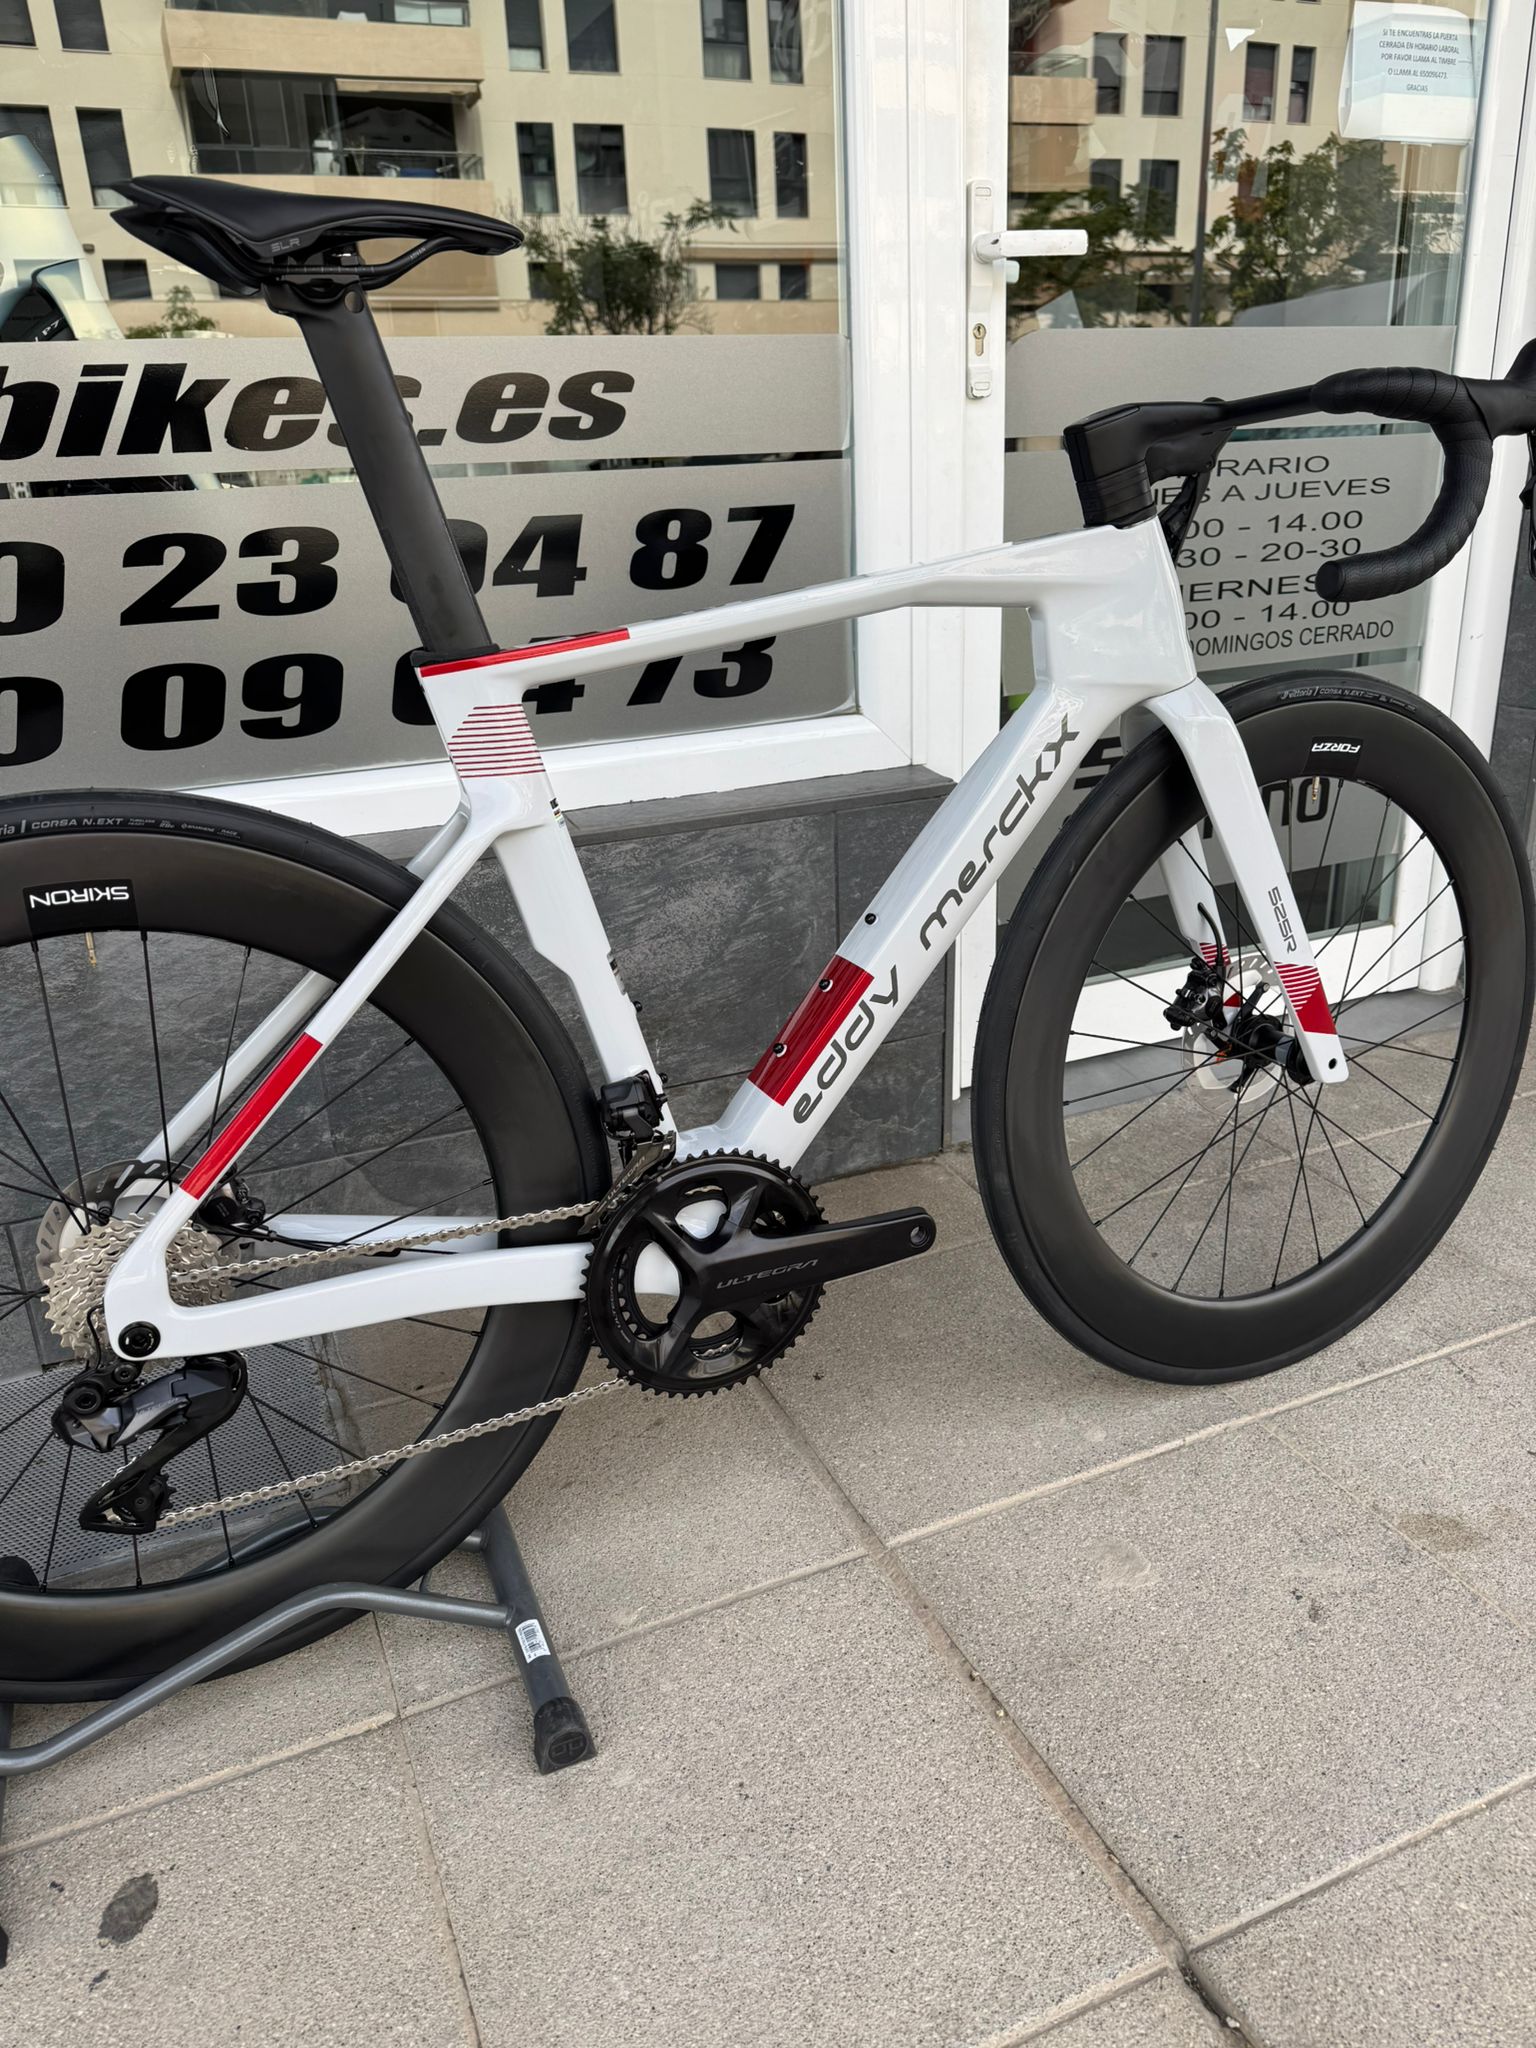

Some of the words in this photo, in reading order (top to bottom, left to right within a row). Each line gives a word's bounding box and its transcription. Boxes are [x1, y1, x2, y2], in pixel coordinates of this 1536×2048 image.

[1382, 28, 1388, 36] SI
[1397, 29, 1432, 39] ENCUENTRAS
[1379, 40, 1405, 48] CERRADA
[1414, 43, 1438, 51] HORARIO
[1438, 45, 1459, 54] LABORAL
[1394, 53, 1412, 61] FAVOR
[1413, 55, 1430, 63] LLAMA
[1406, 83, 1429, 92] GRACIAS
[270, 237, 300, 253] SLR
[1216, 455, 1330, 477] RARIO
[1221, 485, 1246, 502] A
[1254, 477, 1391, 501] JUEVES
[1266, 510, 1363, 534] 14.00
[1260, 537, 1362, 563] 20-30
[119, 526, 340, 627] 23
[629, 504, 796, 591] 87
[1261, 600, 1351, 623] 14.00
[1299, 620, 1395, 646] CERRADO
[120, 653, 345, 752] 09
[1311, 742, 1361, 754] FORZA
[31, 818, 78, 830] CORSA
[82, 817, 124, 826] N.EXT
[29, 886, 130, 909] SKIRON
[792, 964, 899, 1125] eddy
[919, 712, 1081, 952] merckx
[1267, 886, 1297, 954] 525R
[716, 1258, 819, 1290] ULTEGRA
